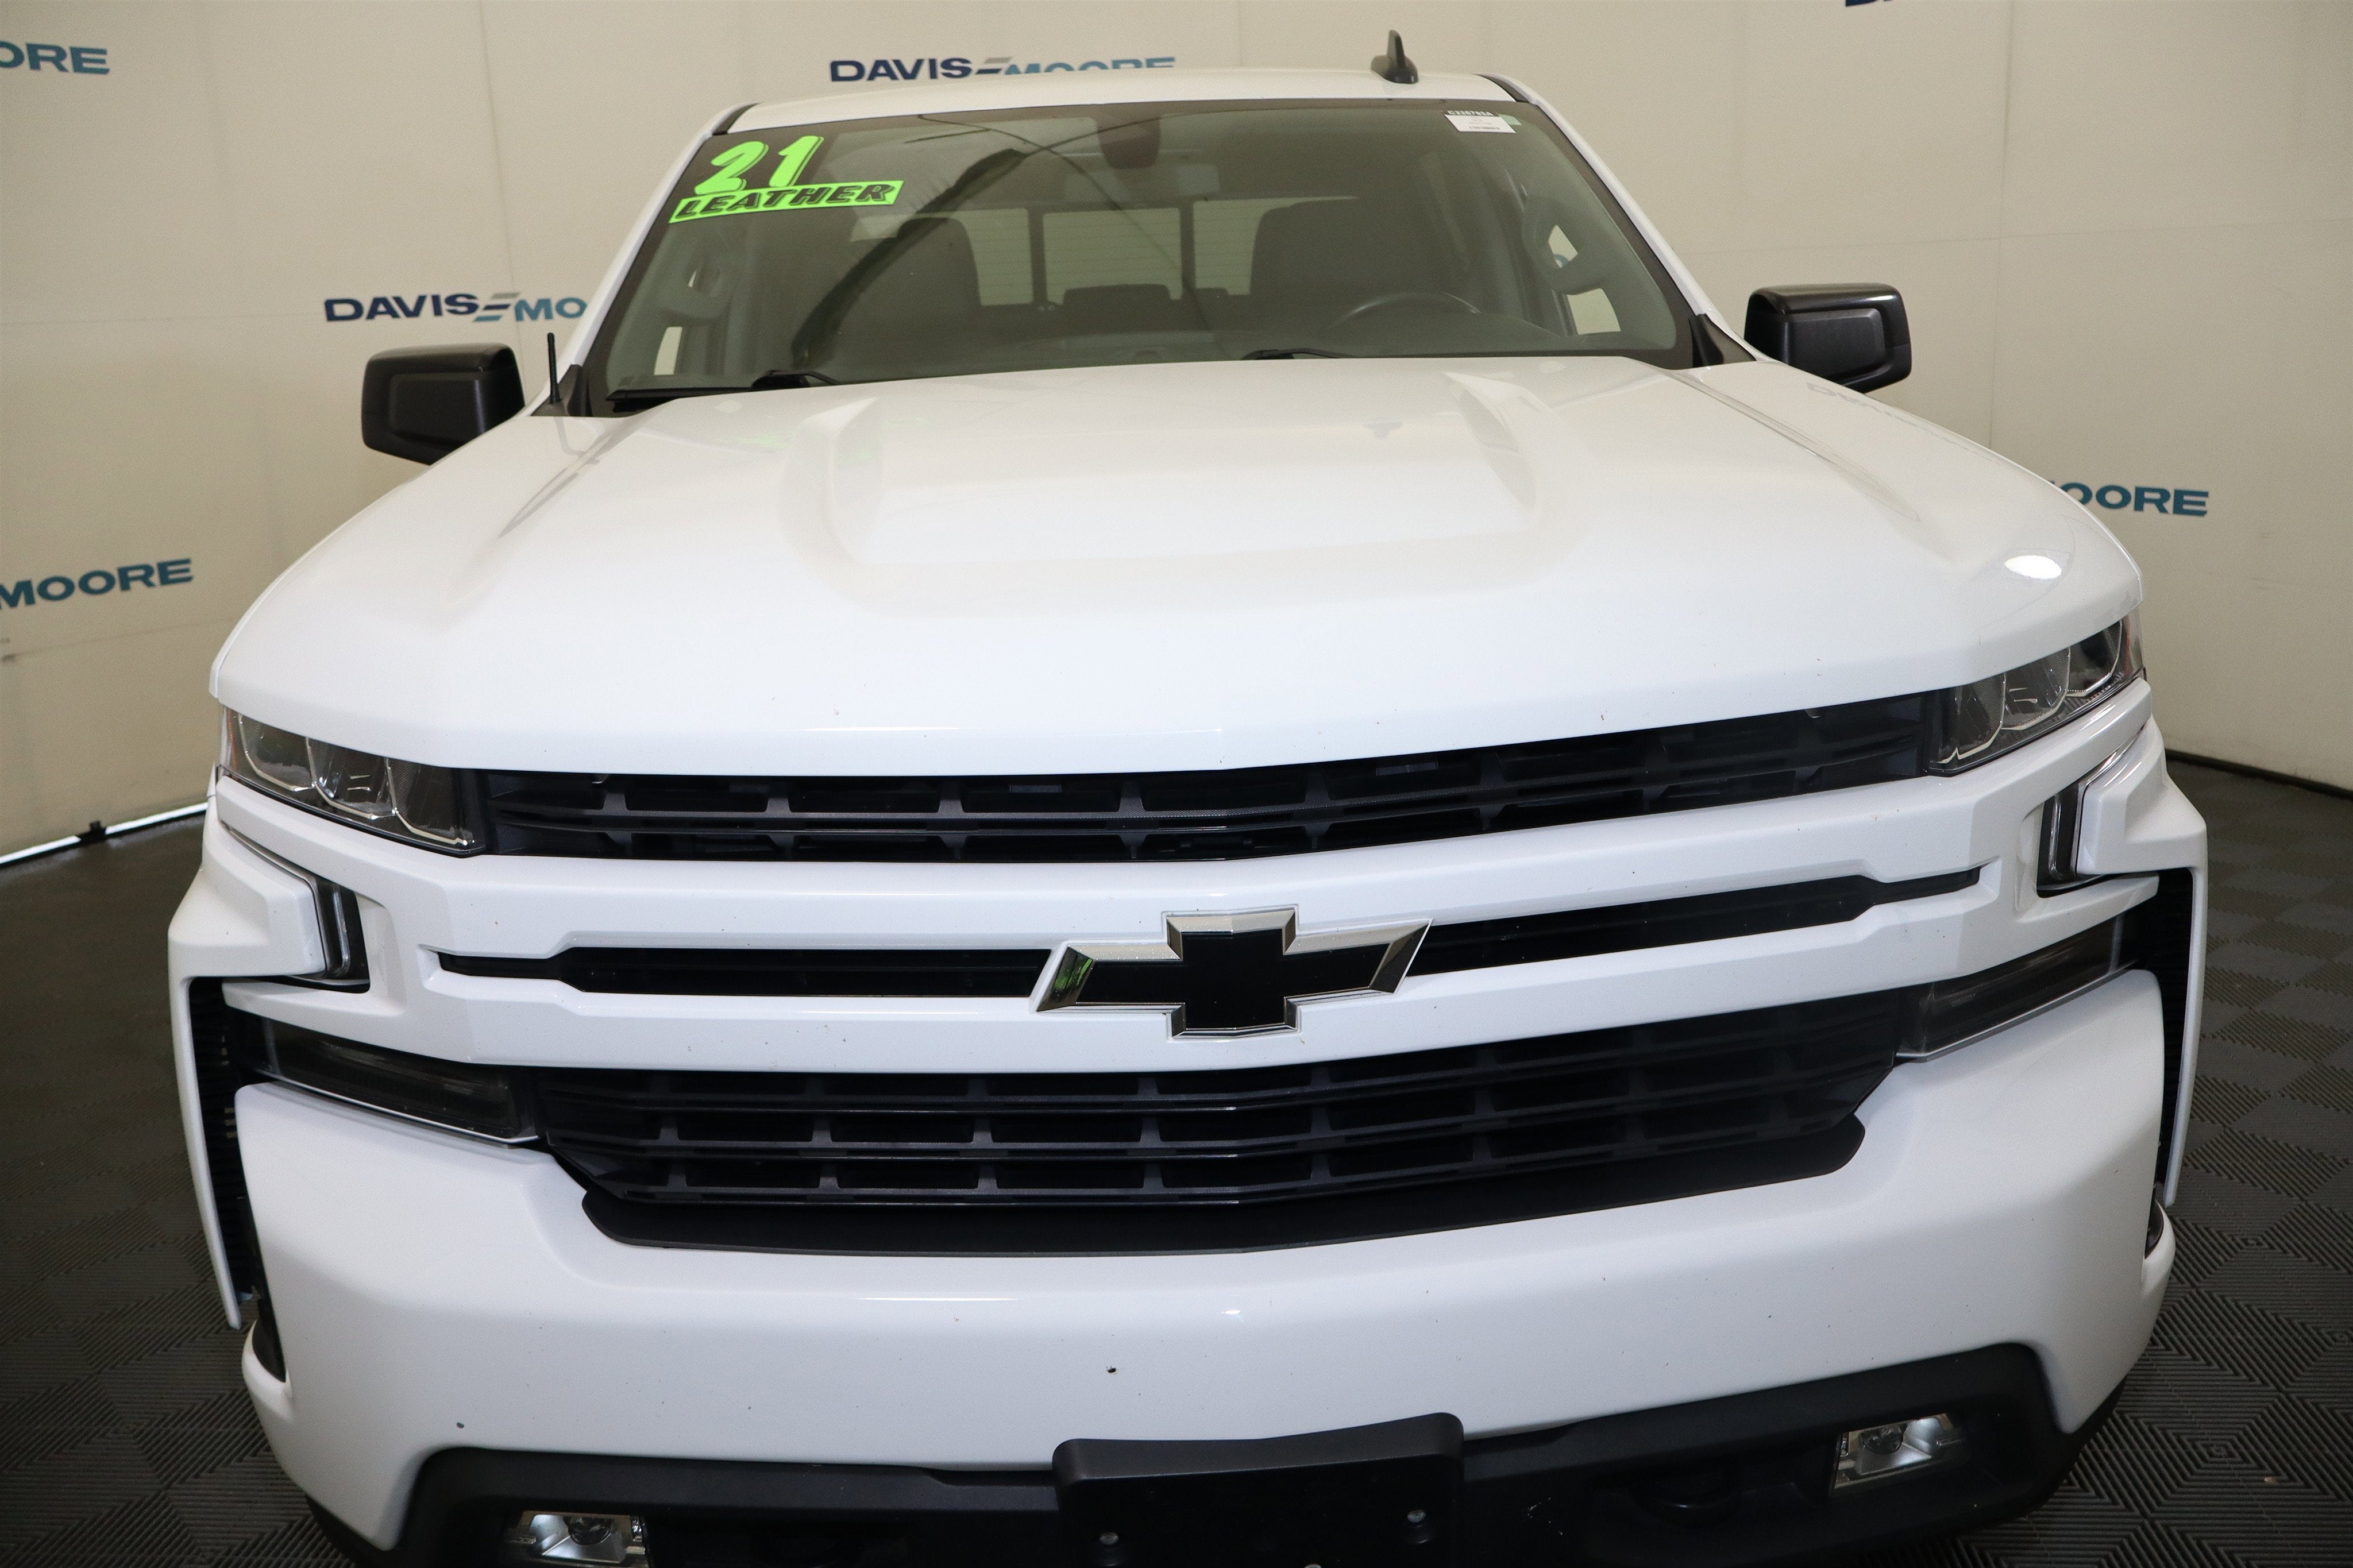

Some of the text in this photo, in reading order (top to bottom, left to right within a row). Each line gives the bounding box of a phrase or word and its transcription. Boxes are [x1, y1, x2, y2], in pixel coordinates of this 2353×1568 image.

[830, 58, 973, 82] DAVIS
[694, 135, 824, 195] 21
[675, 184, 896, 219] LEATHER
[324, 293, 479, 322] DAVIS
[2049, 481, 2209, 517] OORE
[0, 558, 194, 610] MOORE
